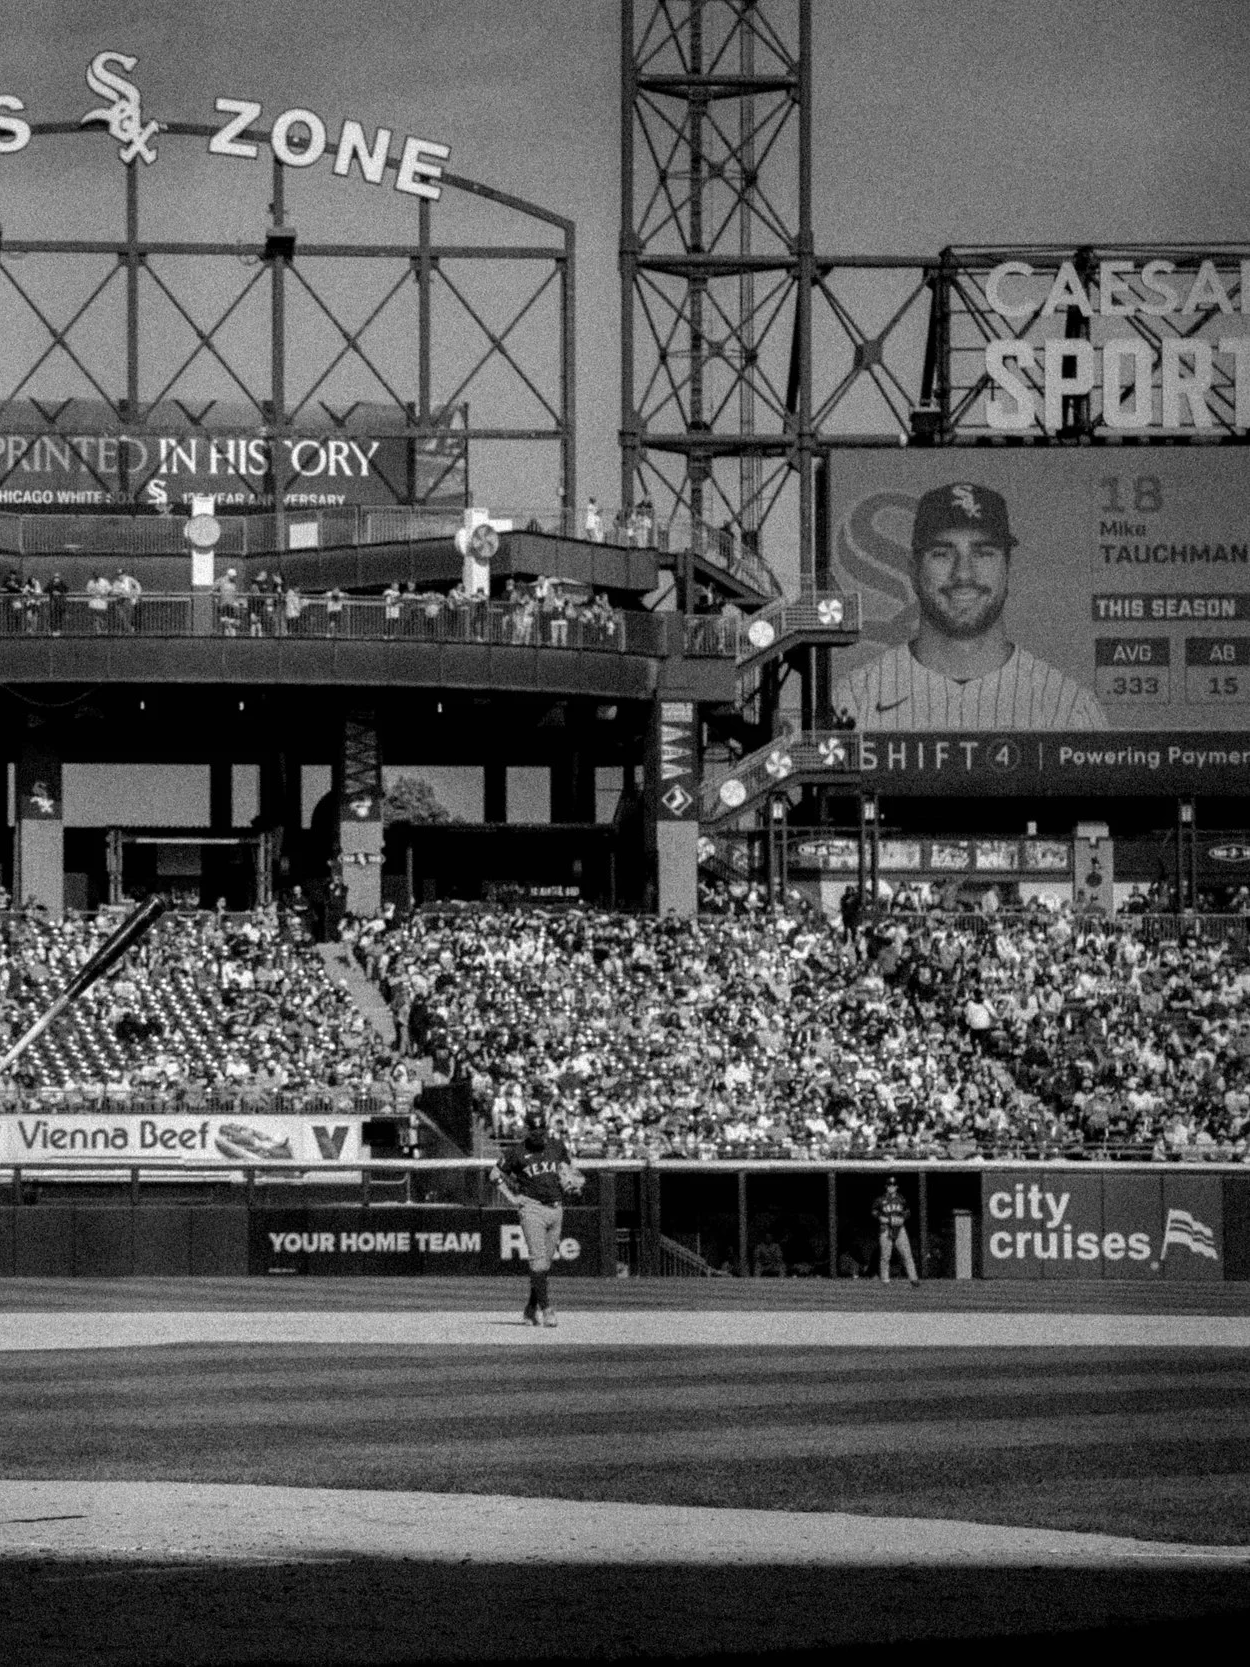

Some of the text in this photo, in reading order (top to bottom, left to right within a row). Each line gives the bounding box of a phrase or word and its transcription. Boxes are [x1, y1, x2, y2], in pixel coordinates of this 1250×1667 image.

[208, 98, 452, 200] ZONE
[985, 259, 1250, 318] CAESA
[159, 437, 197, 474] IN
[210, 439, 381, 477] HISORY
[56, 489, 102, 504] WHITE
[1101, 475, 1163, 514] 18
[1100, 521, 1147, 537] Mike
[1100, 543, 1249, 565] TAUCHMAN
[1098, 600, 1236, 618] THIS SEASON
[1113, 645, 1152, 662] AVG
[1210, 645, 1236, 662] AB
[1106, 677, 1159, 696] .333
[1209, 677, 1239, 696] 15
[860, 742, 979, 771] SHIFT
[1059, 746, 1160, 769] Powering
[17, 1120, 129, 1150] Vienna
[139, 1120, 210, 1150] Beef
[523, 1161, 557, 1179] TEXA
[988, 1183, 1071, 1229] city
[268, 1225, 581, 1260] YOUR HOME TEAM Re
[988, 1223, 1151, 1261] cruises
